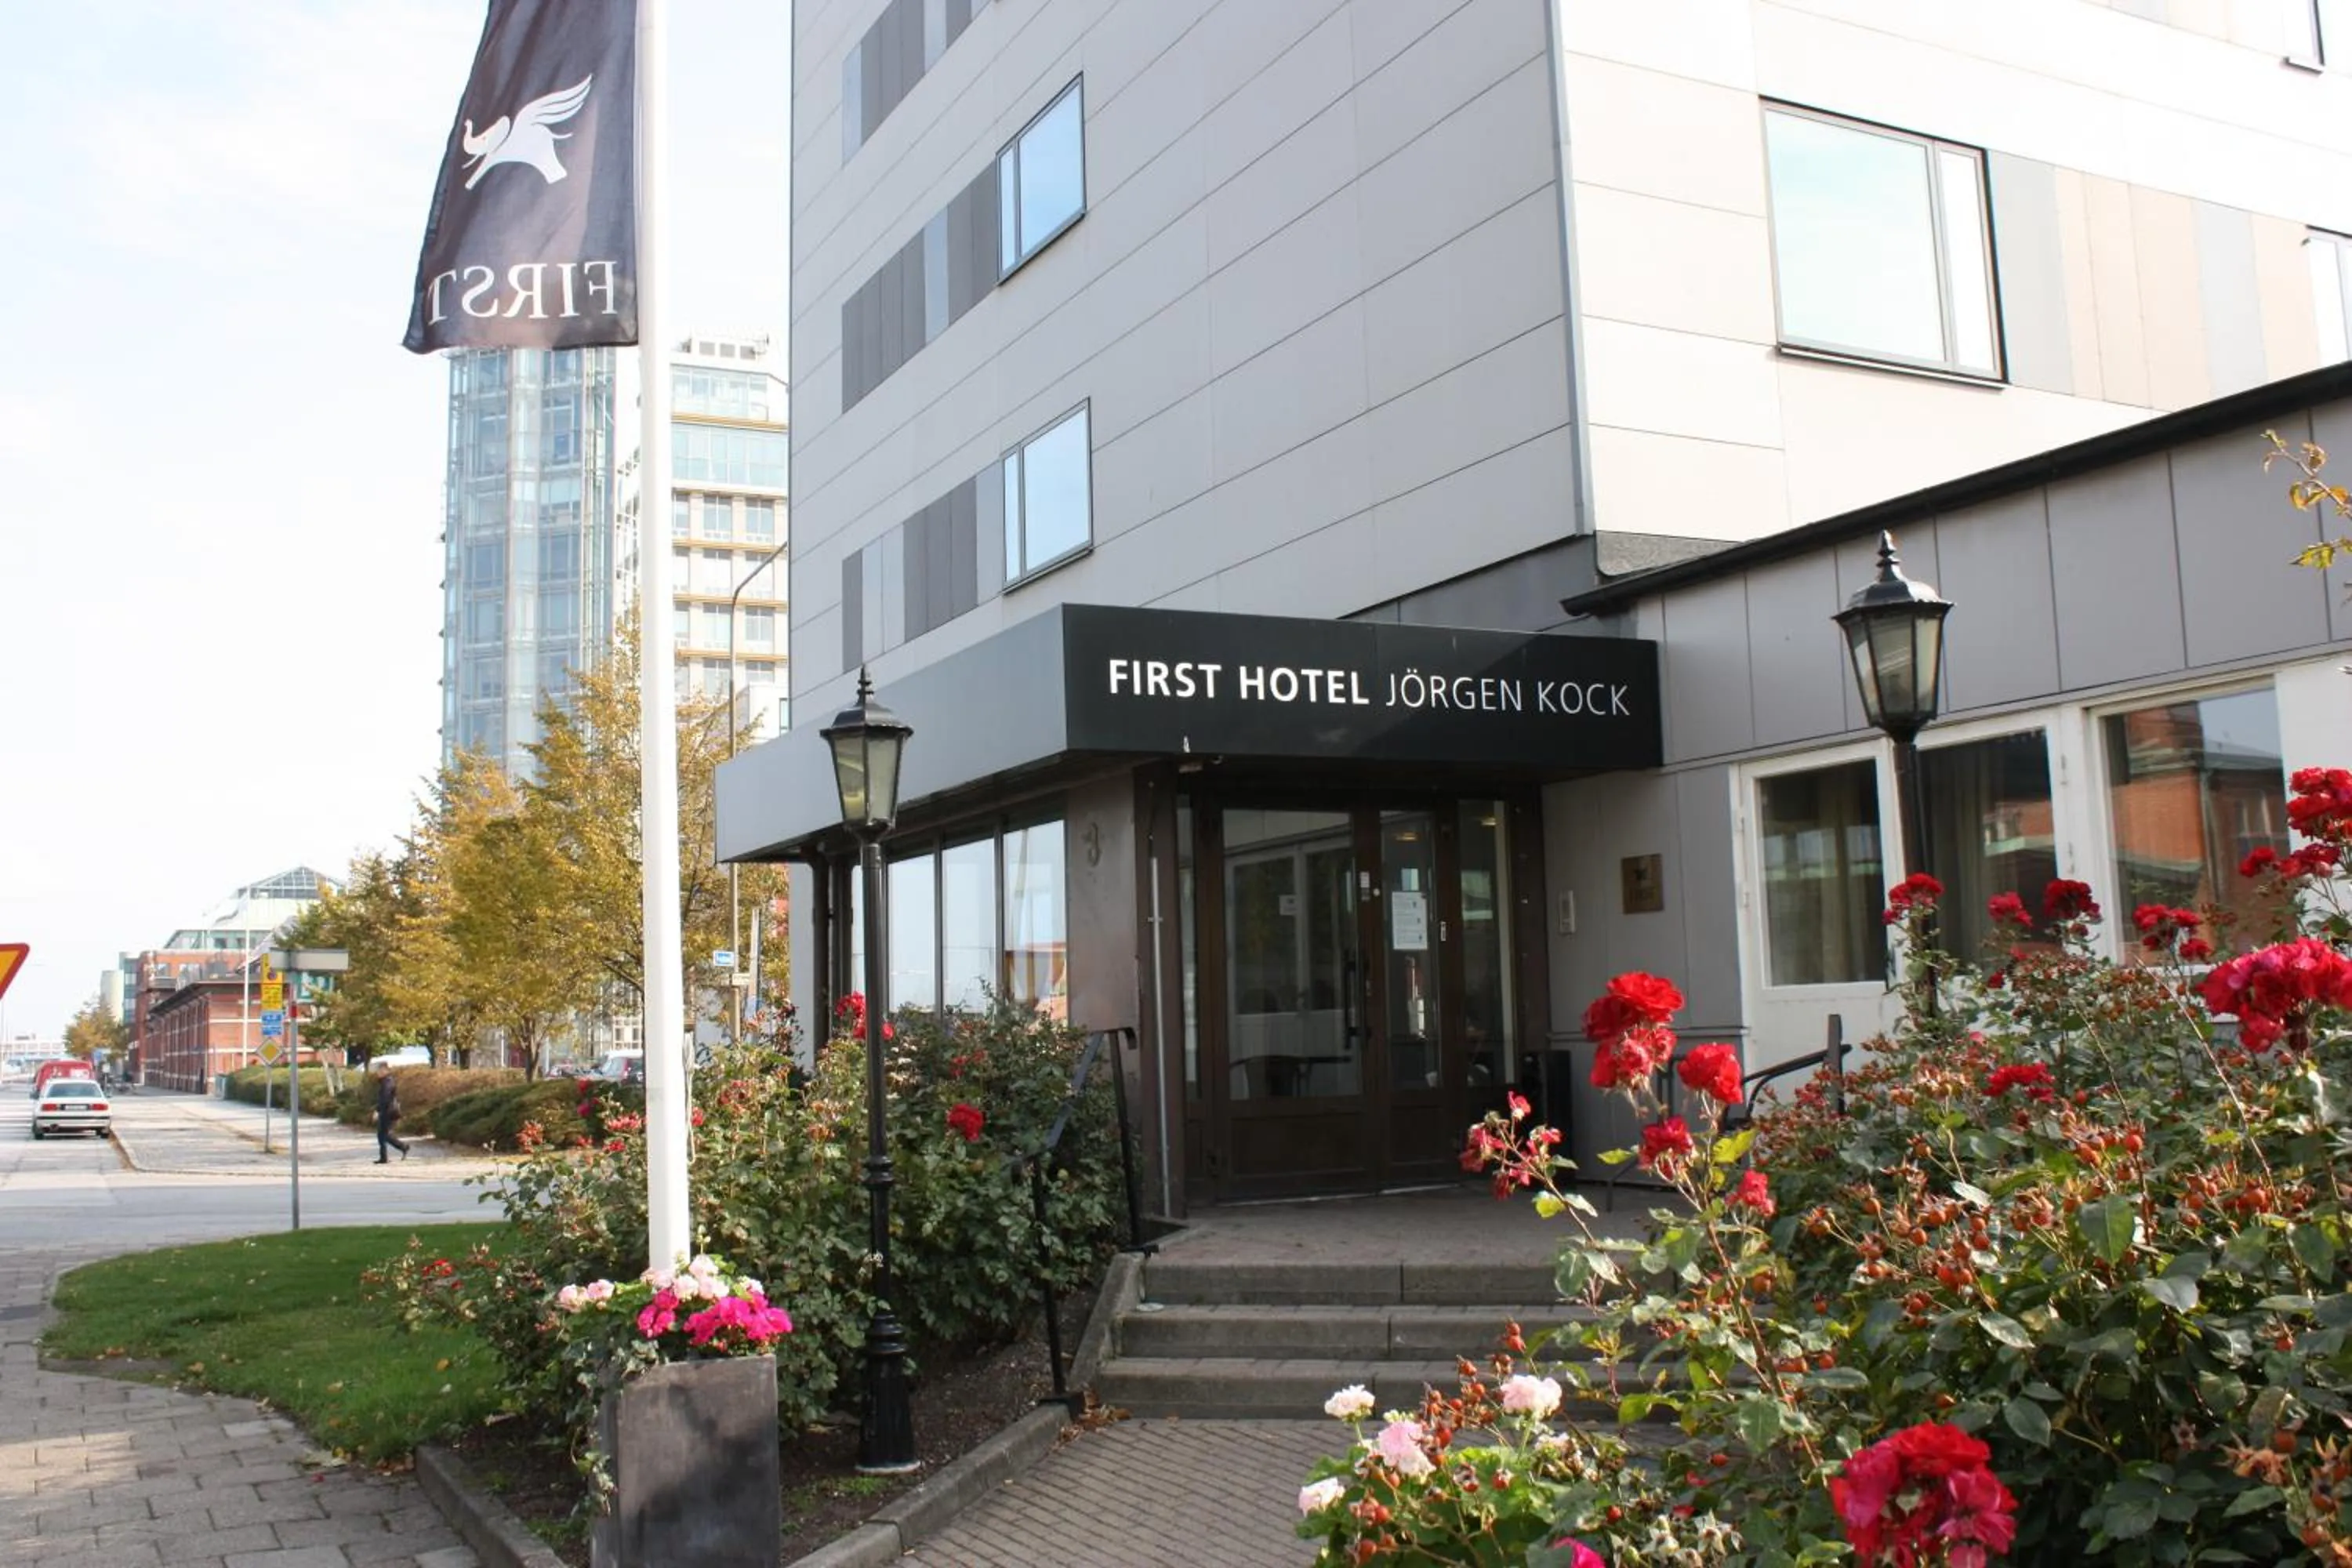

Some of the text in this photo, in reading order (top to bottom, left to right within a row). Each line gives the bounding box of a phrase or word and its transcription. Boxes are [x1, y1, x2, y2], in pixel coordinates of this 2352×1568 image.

[1109, 659, 1630, 716] FIRST HOTEL JÖRGEN KOCK
